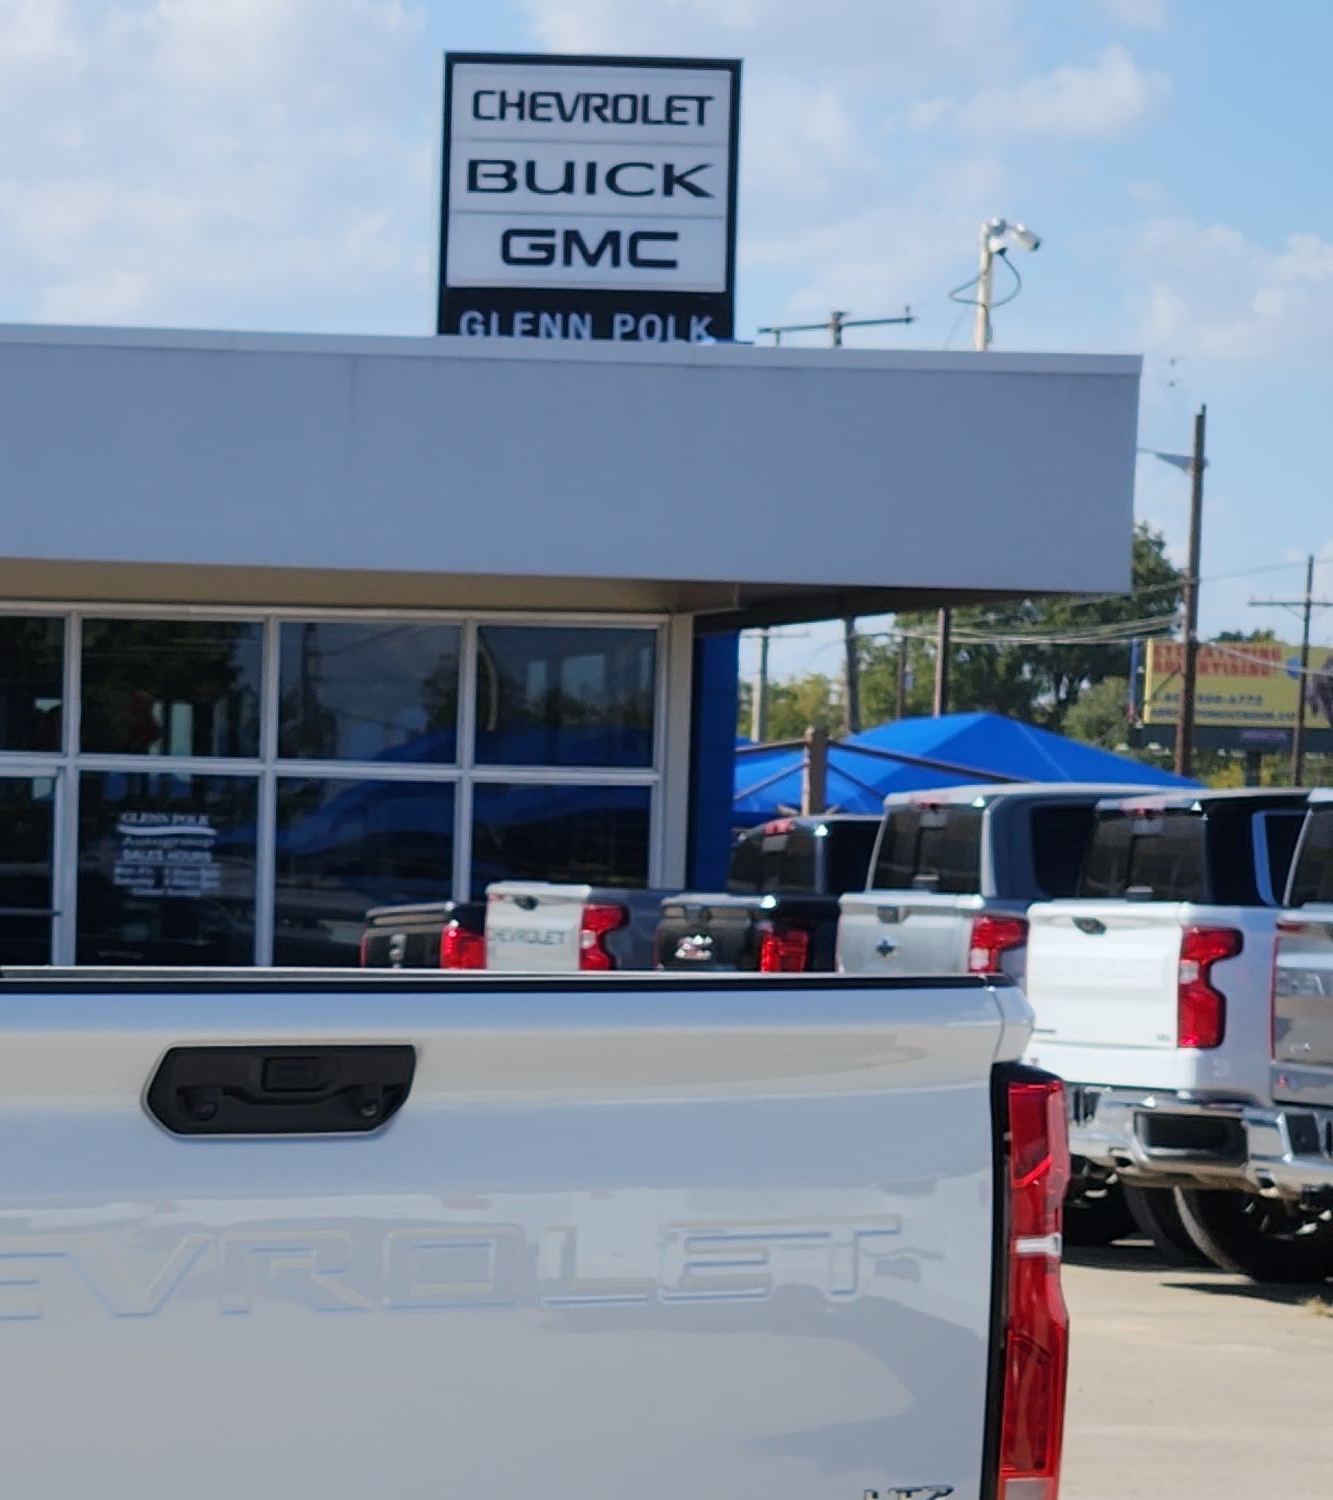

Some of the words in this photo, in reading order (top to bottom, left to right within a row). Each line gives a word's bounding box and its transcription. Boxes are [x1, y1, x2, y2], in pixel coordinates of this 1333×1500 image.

[473, 89, 716, 127] CHEVROLET
[466, 159, 717, 199] BUICK
[501, 228, 680, 270] GMC
[459, 309, 594, 342] GLENN
[613, 311, 715, 343] POLK
